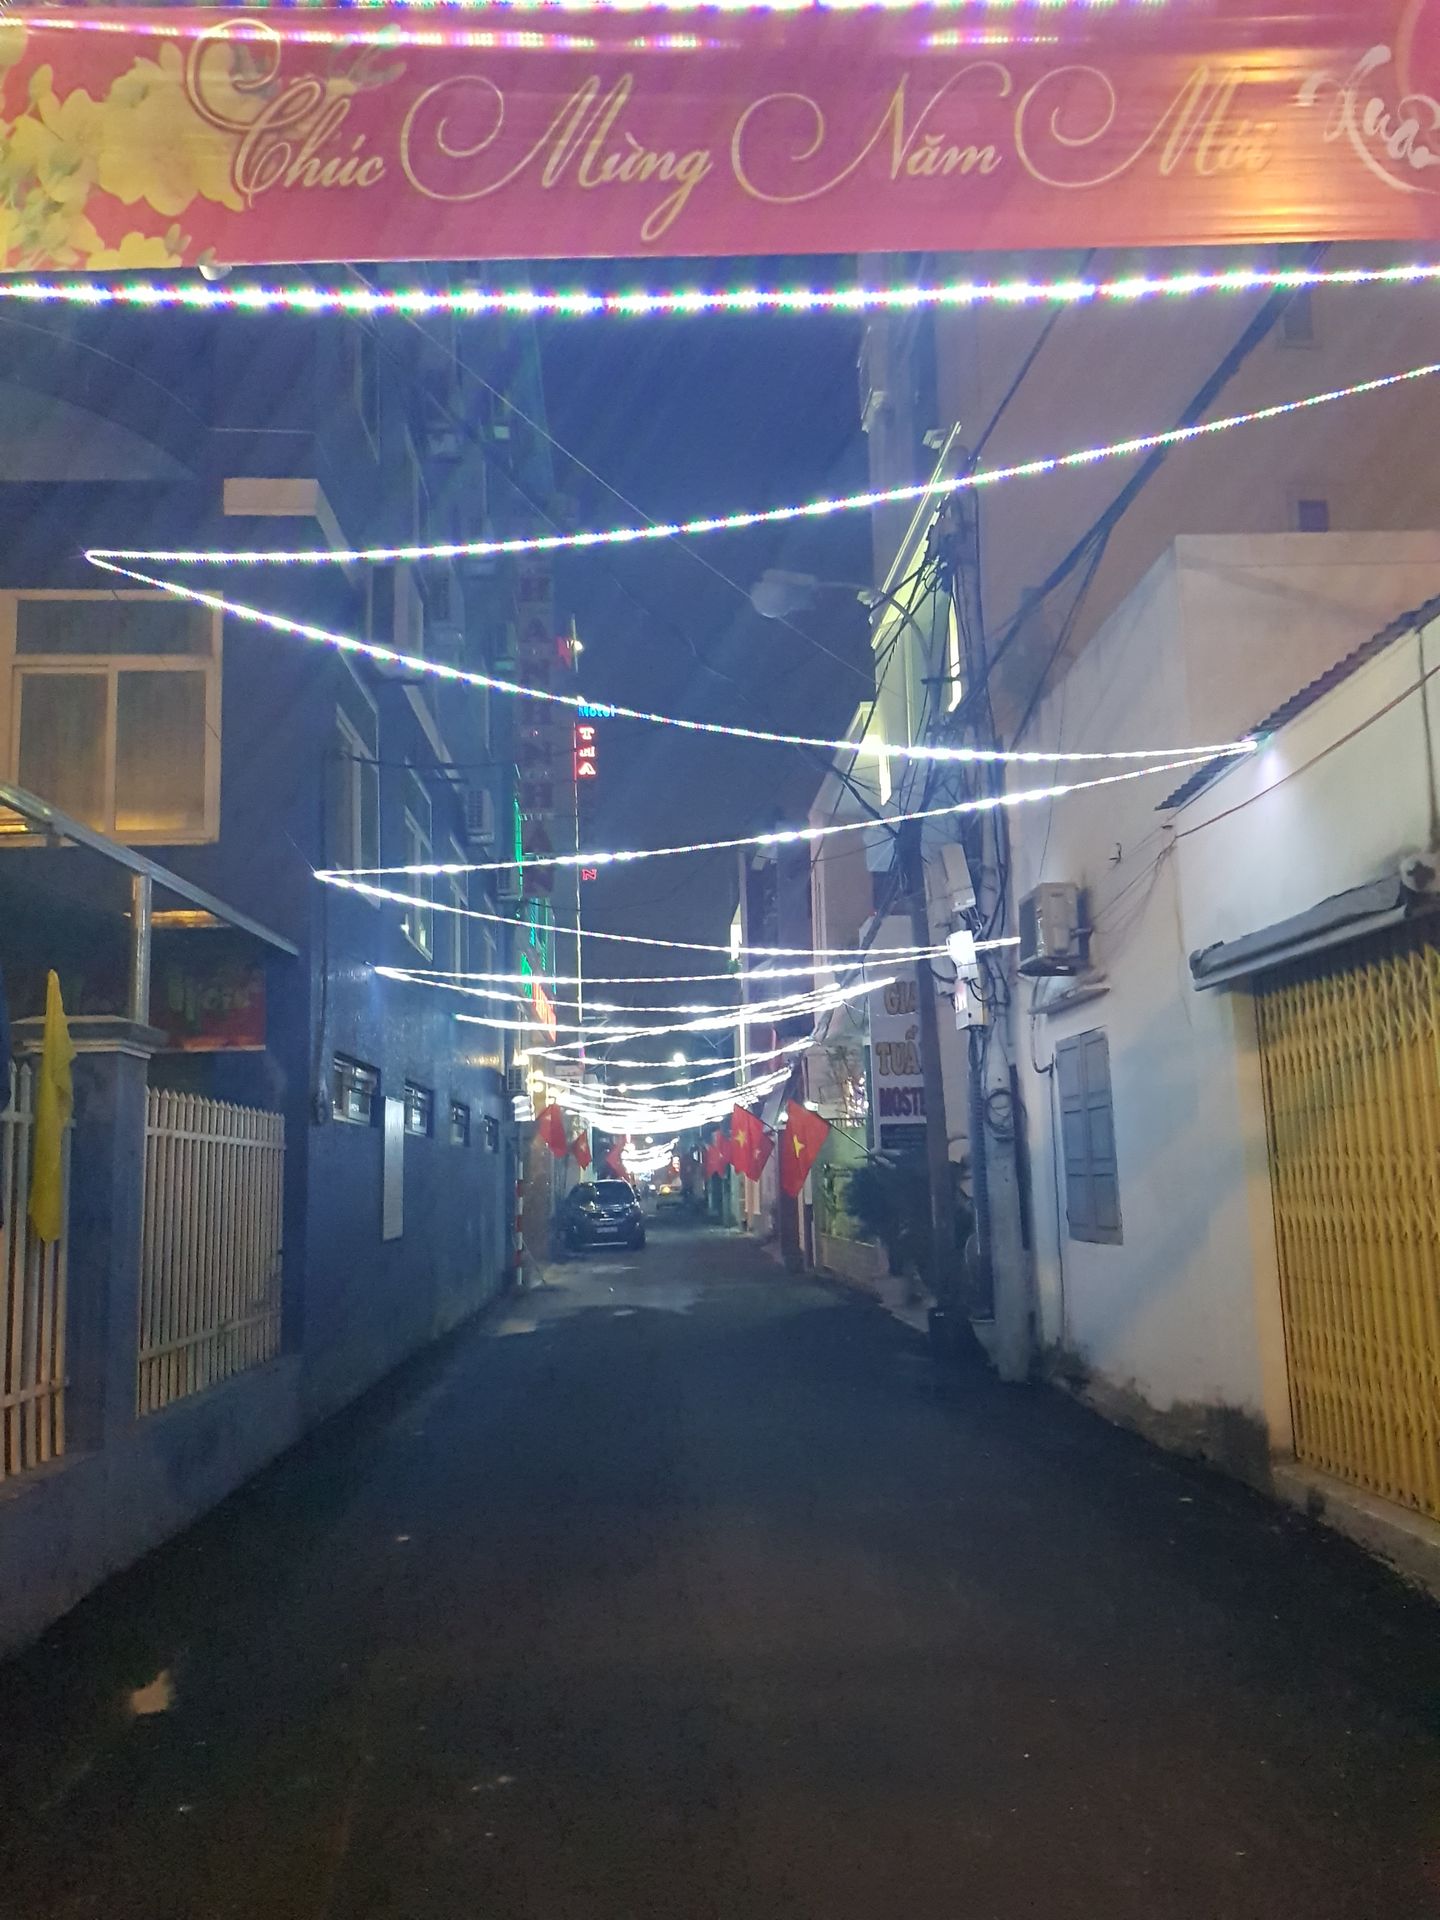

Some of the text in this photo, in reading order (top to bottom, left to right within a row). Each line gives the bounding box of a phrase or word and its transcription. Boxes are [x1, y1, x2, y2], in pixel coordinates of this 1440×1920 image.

[187, 18, 386, 208] Chúc
[400, 73, 711, 241] Mừng
[731, 61, 1011, 203] Năm
[876, 1024, 923, 1076] TUẤ
